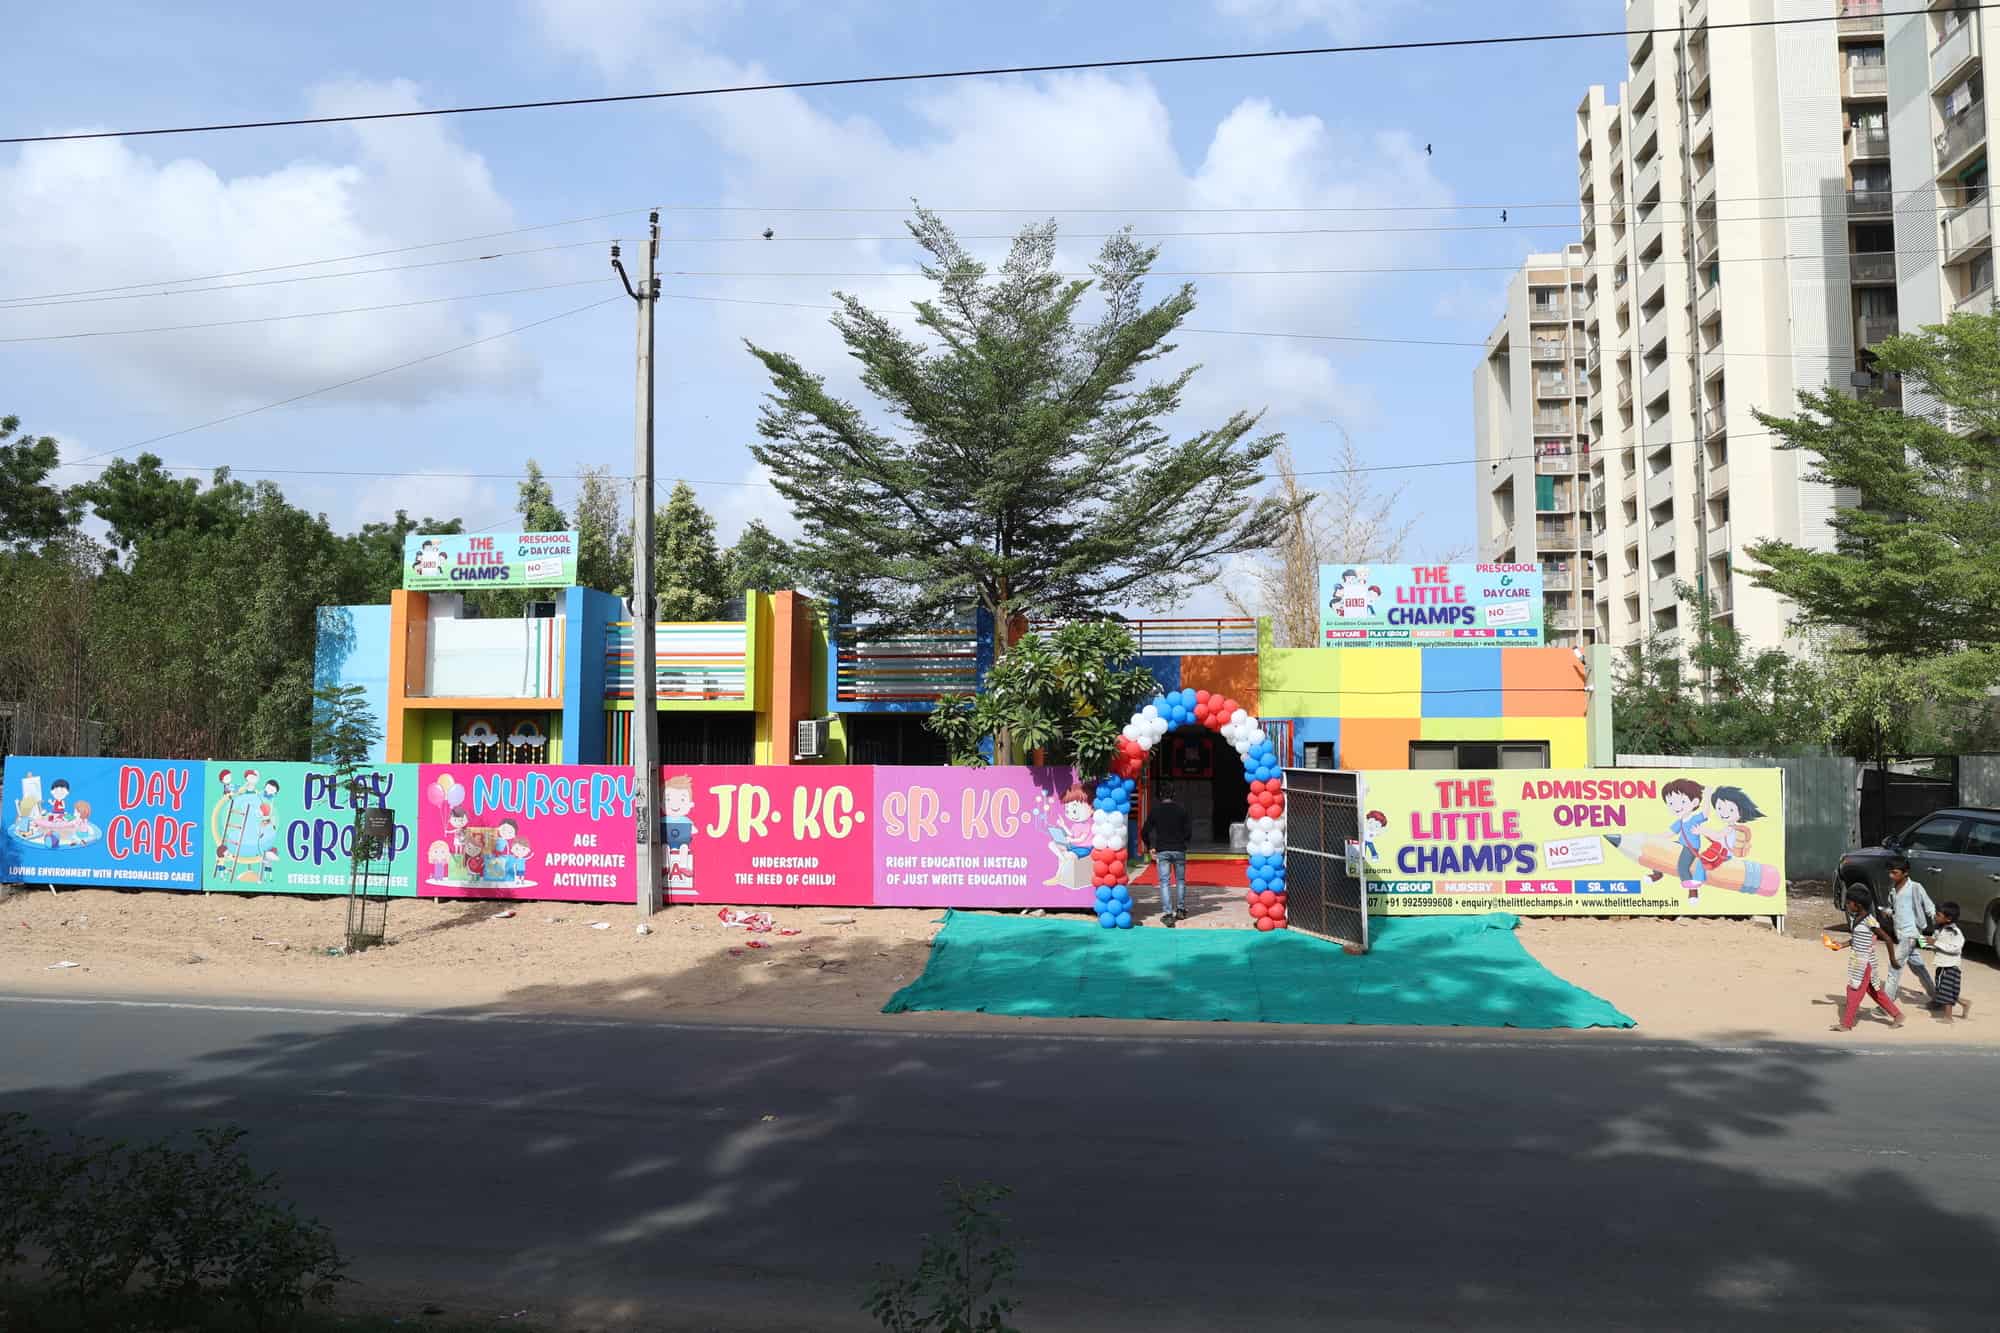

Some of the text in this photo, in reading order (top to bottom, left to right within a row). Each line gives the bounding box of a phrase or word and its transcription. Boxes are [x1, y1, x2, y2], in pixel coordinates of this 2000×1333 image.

[470, 537, 495, 550] THE
[519, 535, 571, 544] PRESCHOOL
[518, 546, 571, 556] & DAYCARE
[457, 552, 504, 565] LITTLE
[450, 566, 510, 581] CHAMPS
[1412, 566, 1451, 584] THE
[1476, 563, 1536, 573] PRESCHOOL
[1501, 575, 1513, 586] &
[1396, 585, 1468, 604] LITTLE
[1483, 588, 1531, 598] DAYCARE
[1387, 605, 1476, 625] CHAMPS
[1488, 608, 1504, 616] NO
[119, 765, 188, 811] DAY
[304, 772, 394, 810] PLAY
[1435, 779, 1496, 808] THE
[1522, 780, 1656, 800] ADMISSION
[473, 771, 637, 821] NURSERY
[706, 783, 782, 843] JR.
[793, 785, 865, 841] KG.
[882, 785, 1032, 842] SR. KG.
[1553, 804, 1626, 827] OPEN
[1410, 811, 1521, 840] LITTLE
[107, 814, 197, 863] CARE
[287, 818, 410, 865] GROP
[574, 834, 597, 848] AGE
[1549, 846, 1568, 856] NO
[545, 853, 625, 868] APPROPRIATE
[752, 857, 819, 869] UNDERSTAND
[886, 857, 1028, 869] RIGHT EDUCATION INSTEAD
[1397, 843, 1536, 875] CHAMPS
[9, 865, 36, 876] LOVING
[38, 867, 92, 878] ENVIRONMENT
[93, 869, 112, 878] WITH
[113, 870, 170, 881] PERSONALISED
[287, 873, 321, 885] STRESS
[323, 874, 345, 885] FREE
[735, 873, 836, 886] THE NEED OF CHILD!
[887, 874, 1027, 886] OF JUST WRITE EDUCATION
[553, 874, 616, 888] ACTIVITIES
[1368, 883, 1431, 892] PLAY GROUP
[1445, 883, 1493, 892] NURSERY
[1519, 883, 1559, 892] JR. KG.
[1588, 882, 1628, 892] SR. KG.
[1385, 898, 1402, 907] +91
[1403, 897, 1453, 907] 9925999608
[1461, 897, 1573, 908] enquiry@thelittlechamps.in
[1582, 897, 1679, 908] www.thelittlechamps.in
